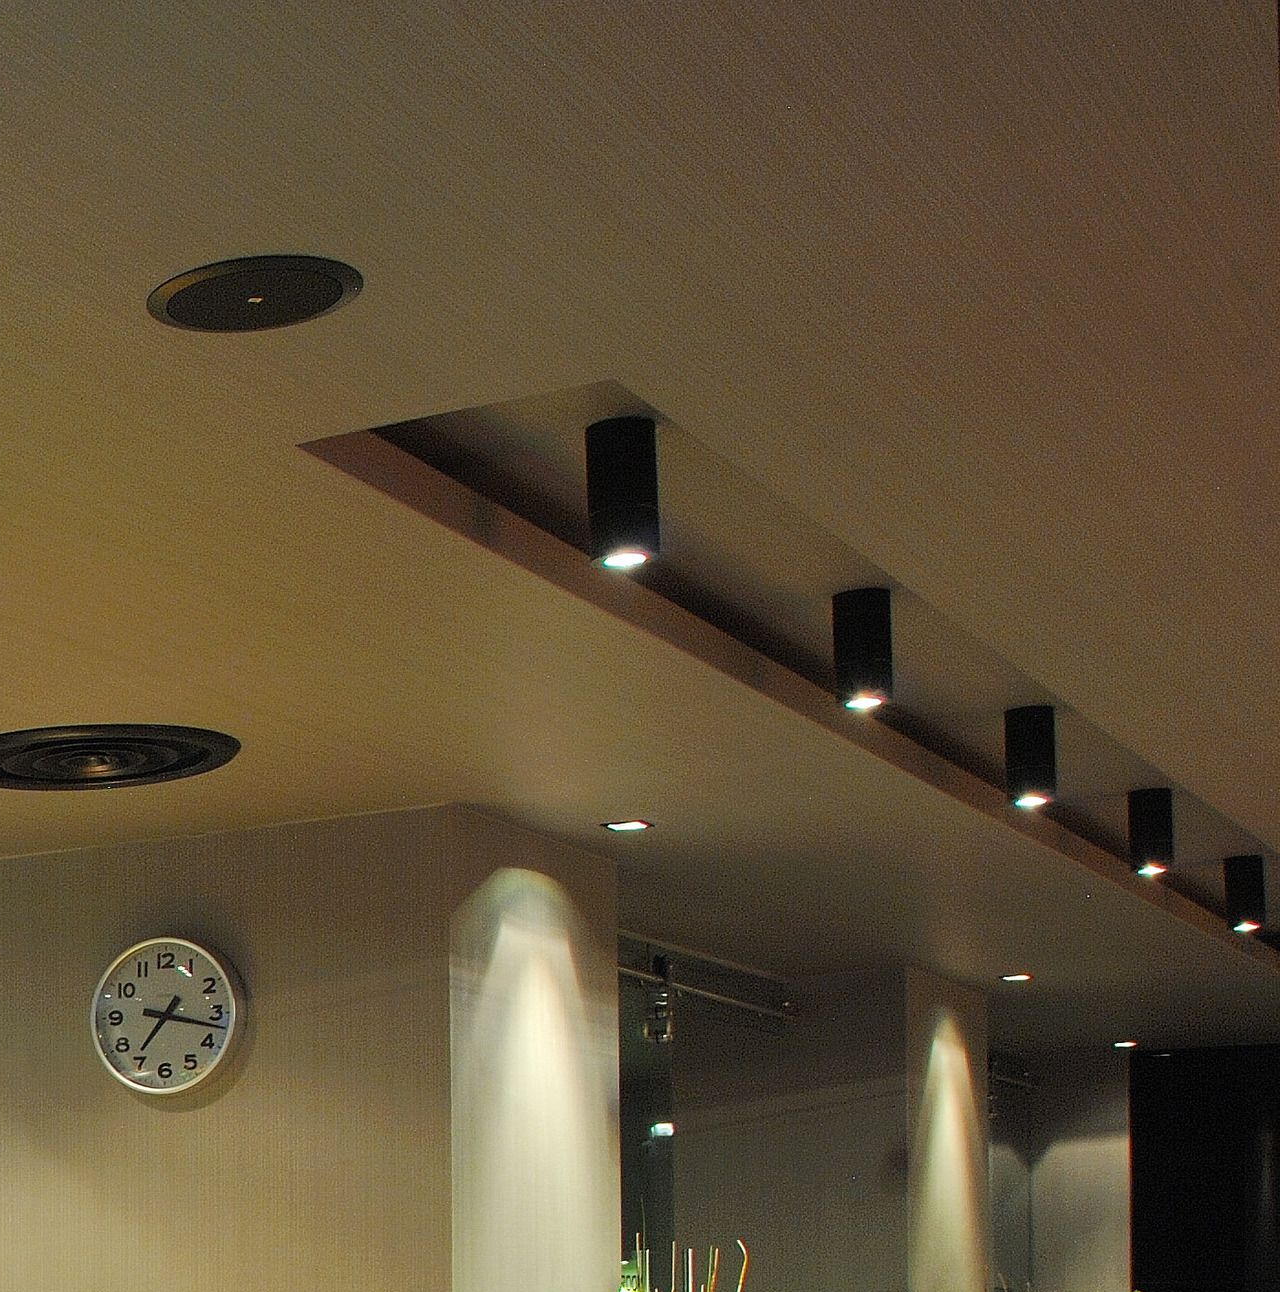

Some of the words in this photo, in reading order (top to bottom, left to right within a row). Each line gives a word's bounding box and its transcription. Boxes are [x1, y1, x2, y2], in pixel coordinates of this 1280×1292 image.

[157, 952, 175, 969] 12
[138, 961, 148, 977] 11
[118, 983, 136, 998] 10
[203, 978, 216, 994] 2
[108, 1011, 123, 1026] 9
[209, 1005, 223, 1021] 3
[116, 1037, 130, 1053] 8
[200, 1033, 214, 1049] 4
[133, 1056, 147, 1071] 7
[184, 1054, 197, 1070] 5
[158, 1063, 172, 1078] 6
